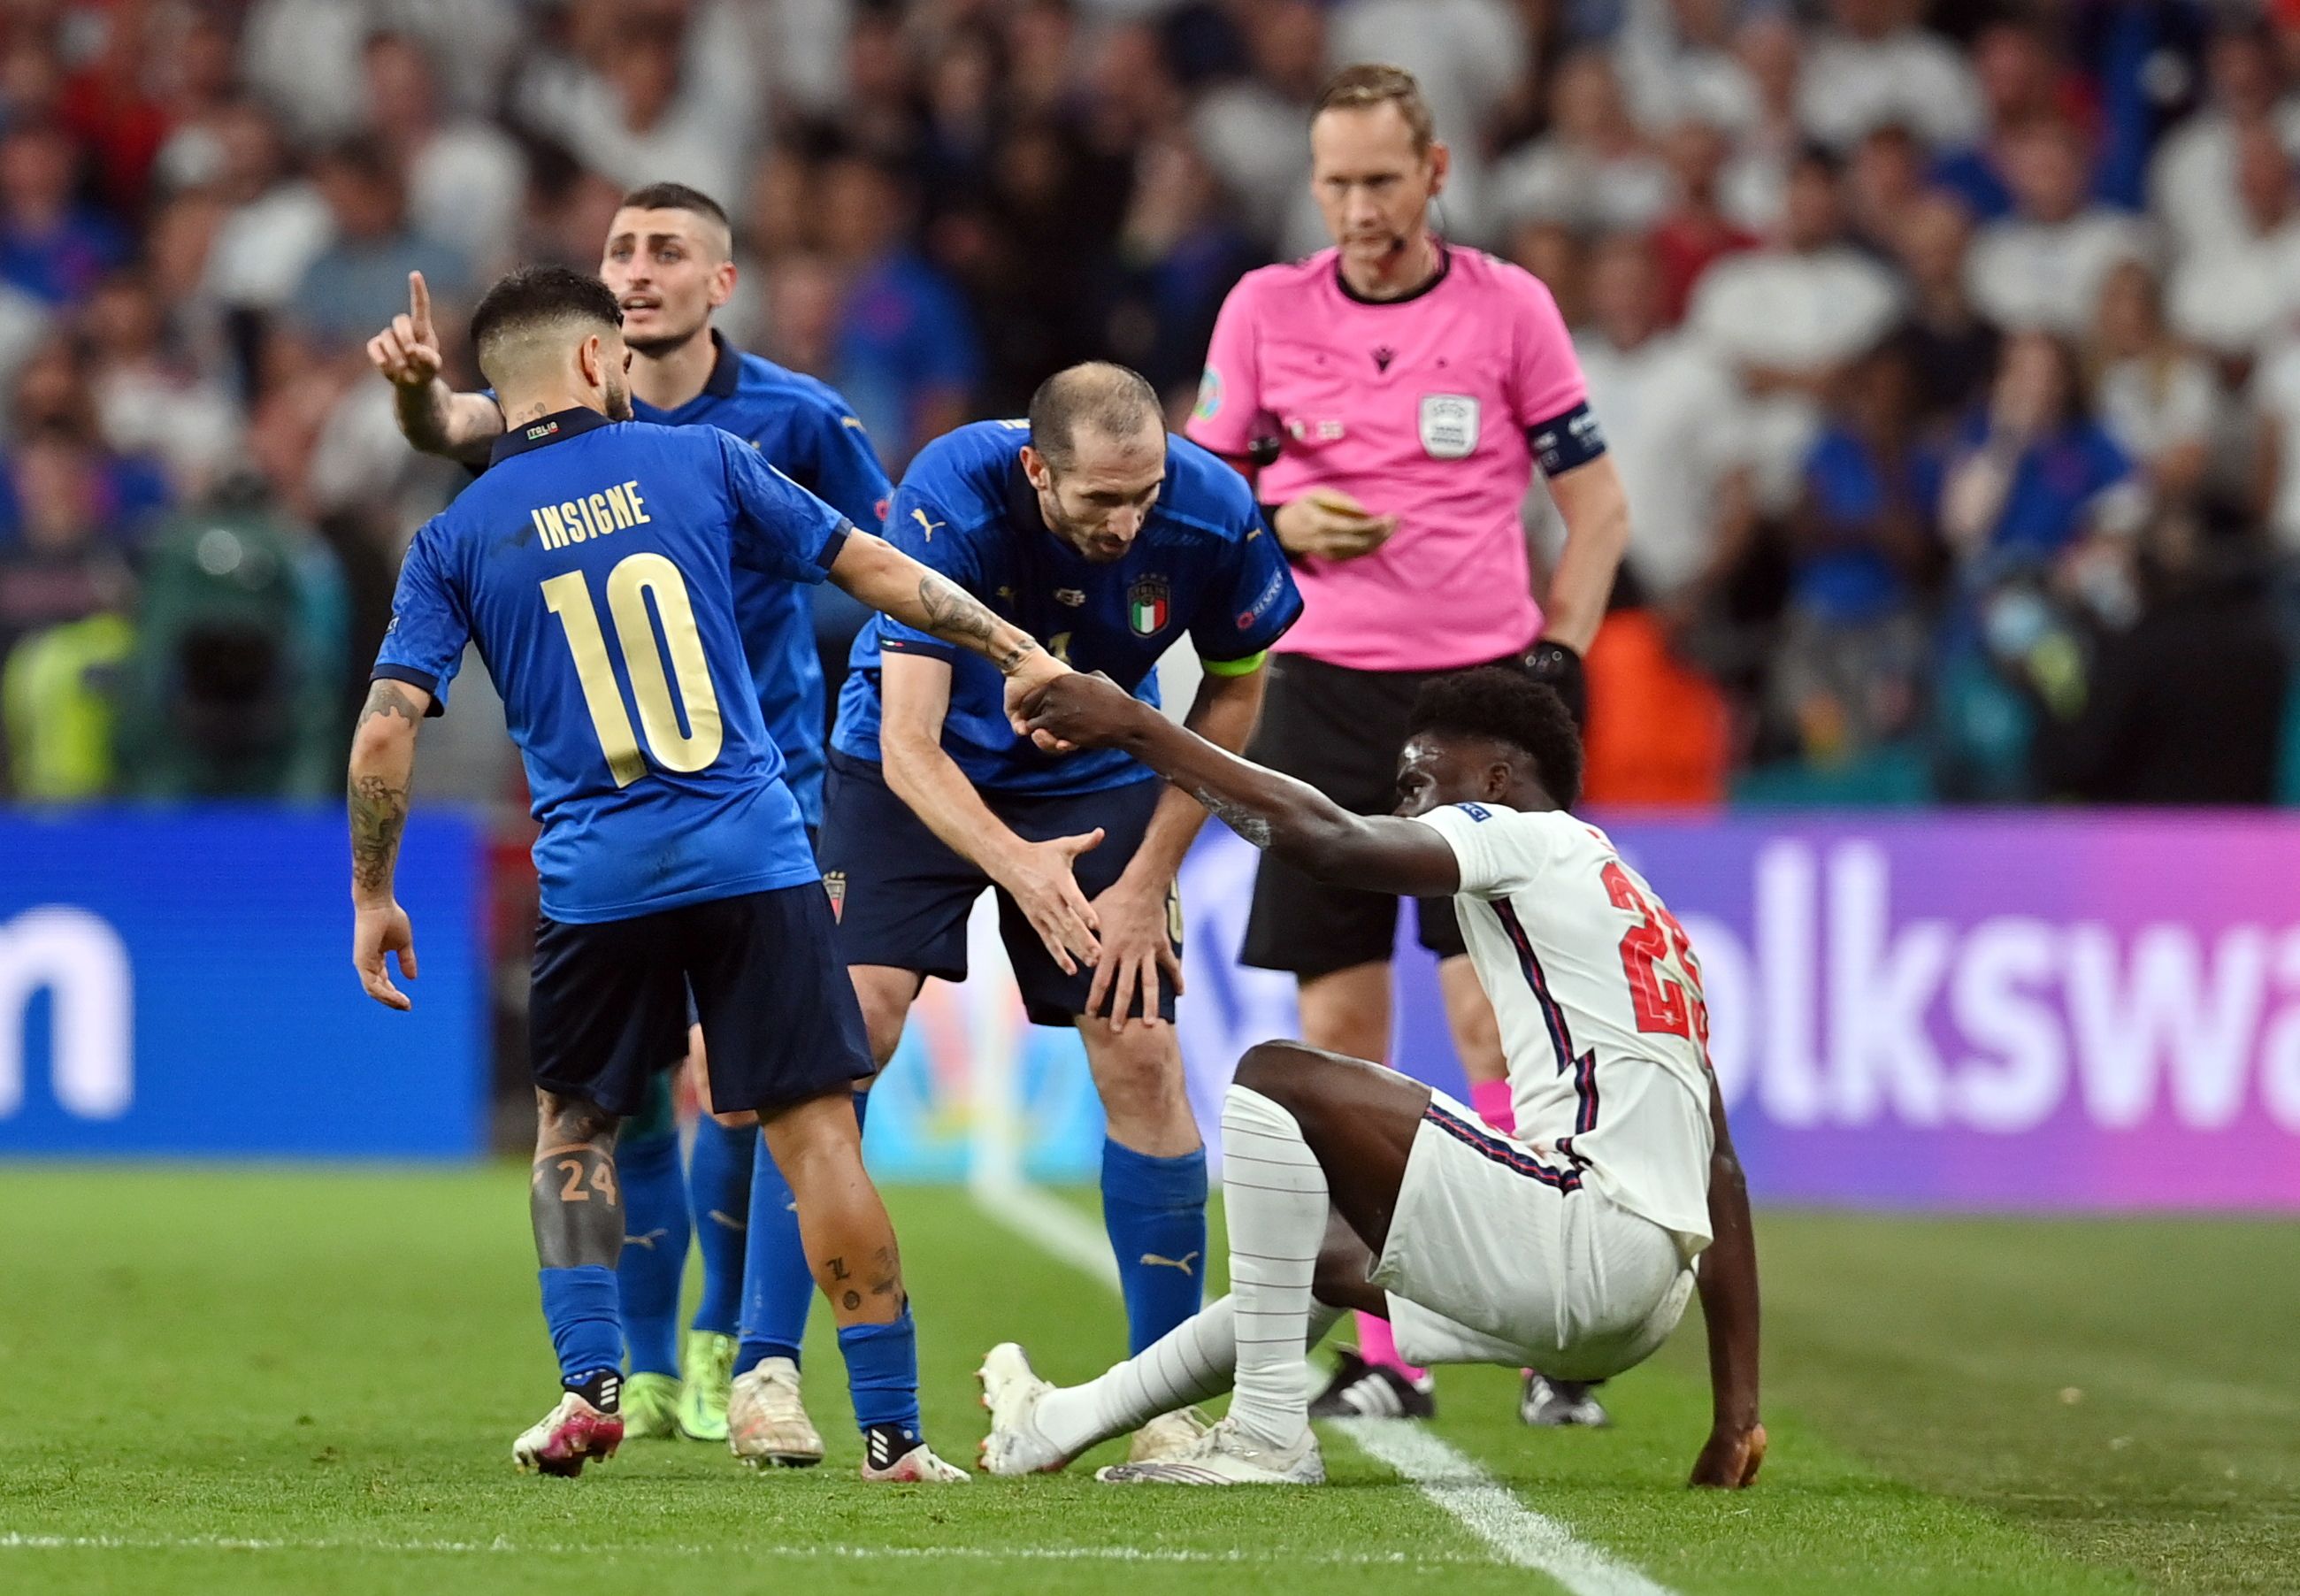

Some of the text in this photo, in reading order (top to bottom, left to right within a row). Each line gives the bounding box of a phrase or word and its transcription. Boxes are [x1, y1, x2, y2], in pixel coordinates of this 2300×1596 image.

[526, 421, 558, 439] ITALIA
[531, 480, 650, 551] INSIGNE
[540, 552, 724, 789] 10
[557, 1159, 617, 1206] 24
